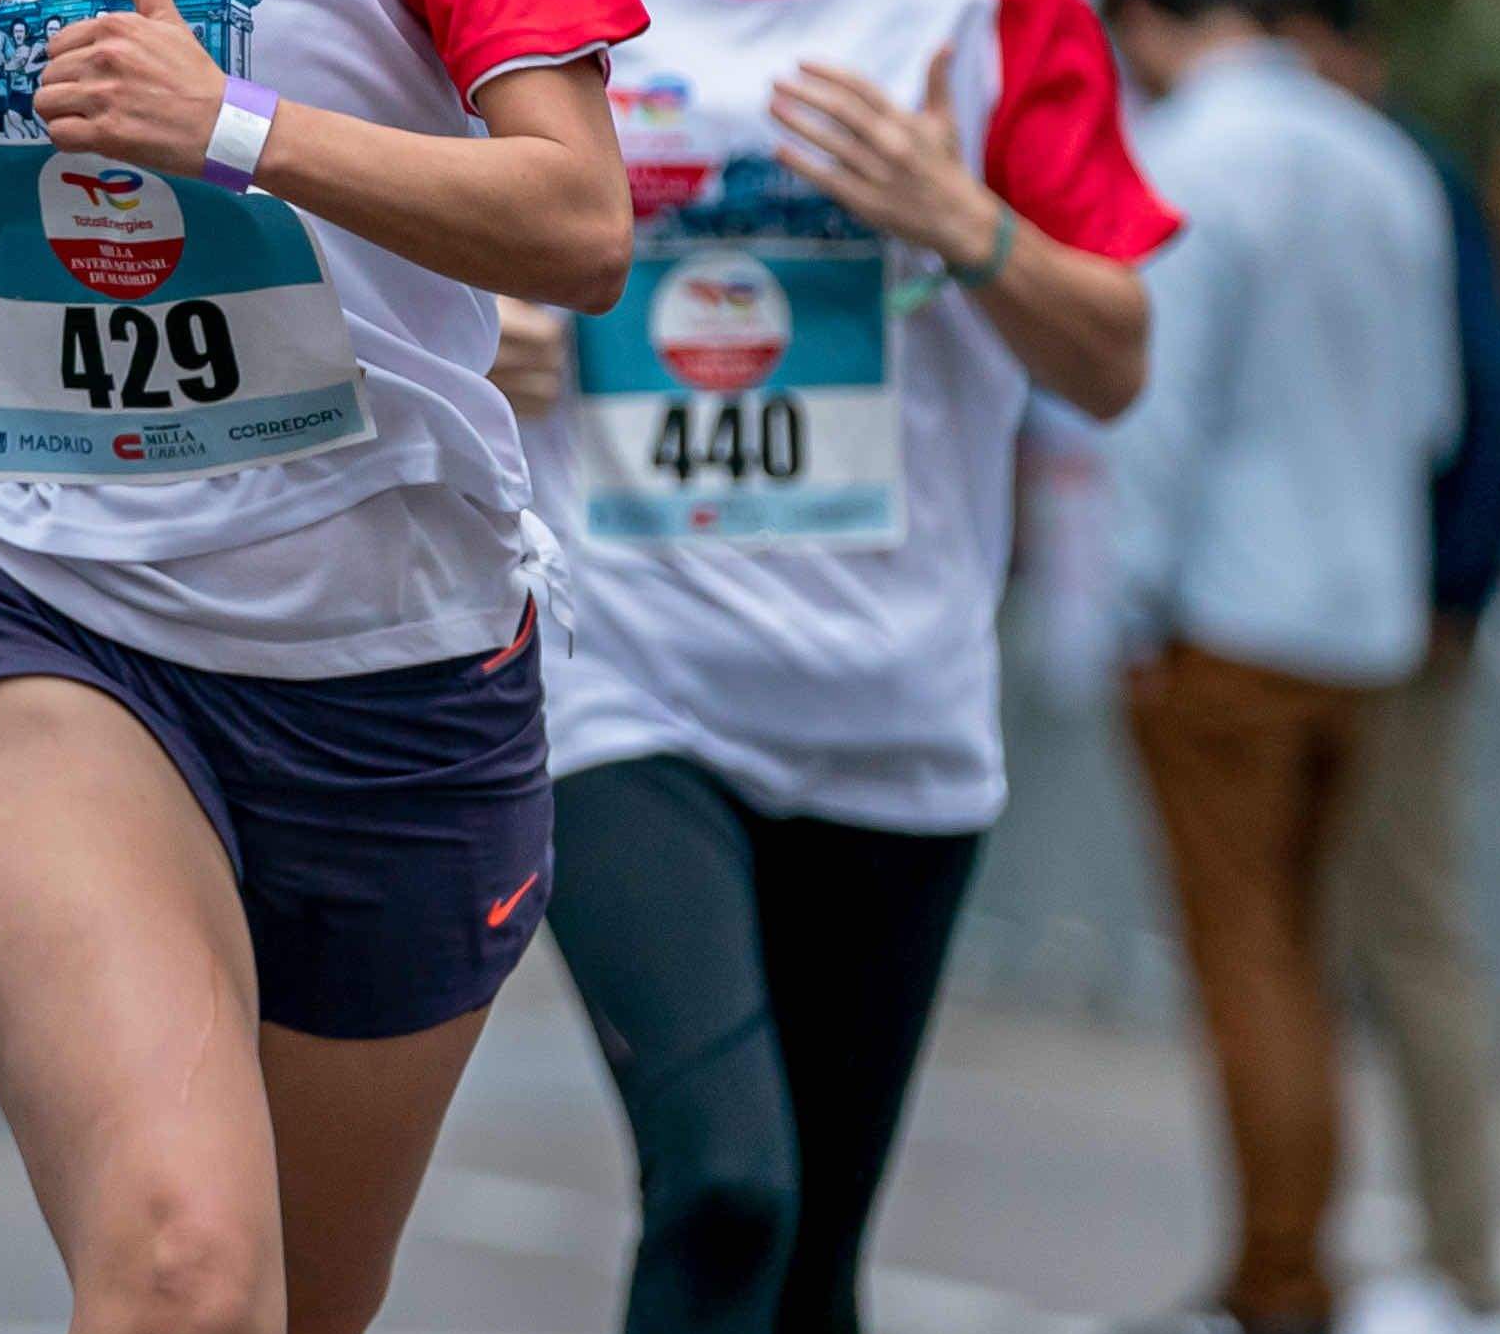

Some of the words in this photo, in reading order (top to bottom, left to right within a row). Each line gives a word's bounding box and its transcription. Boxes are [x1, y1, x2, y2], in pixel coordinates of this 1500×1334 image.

[73, 216, 154, 234] TotalEnergies
[61, 300, 240, 409] 429
[19, 433, 94, 455] MADRID
[145, 430, 195, 445] MILLA
[652, 398, 802, 483] 440
[148, 443, 207, 460] URBANA
